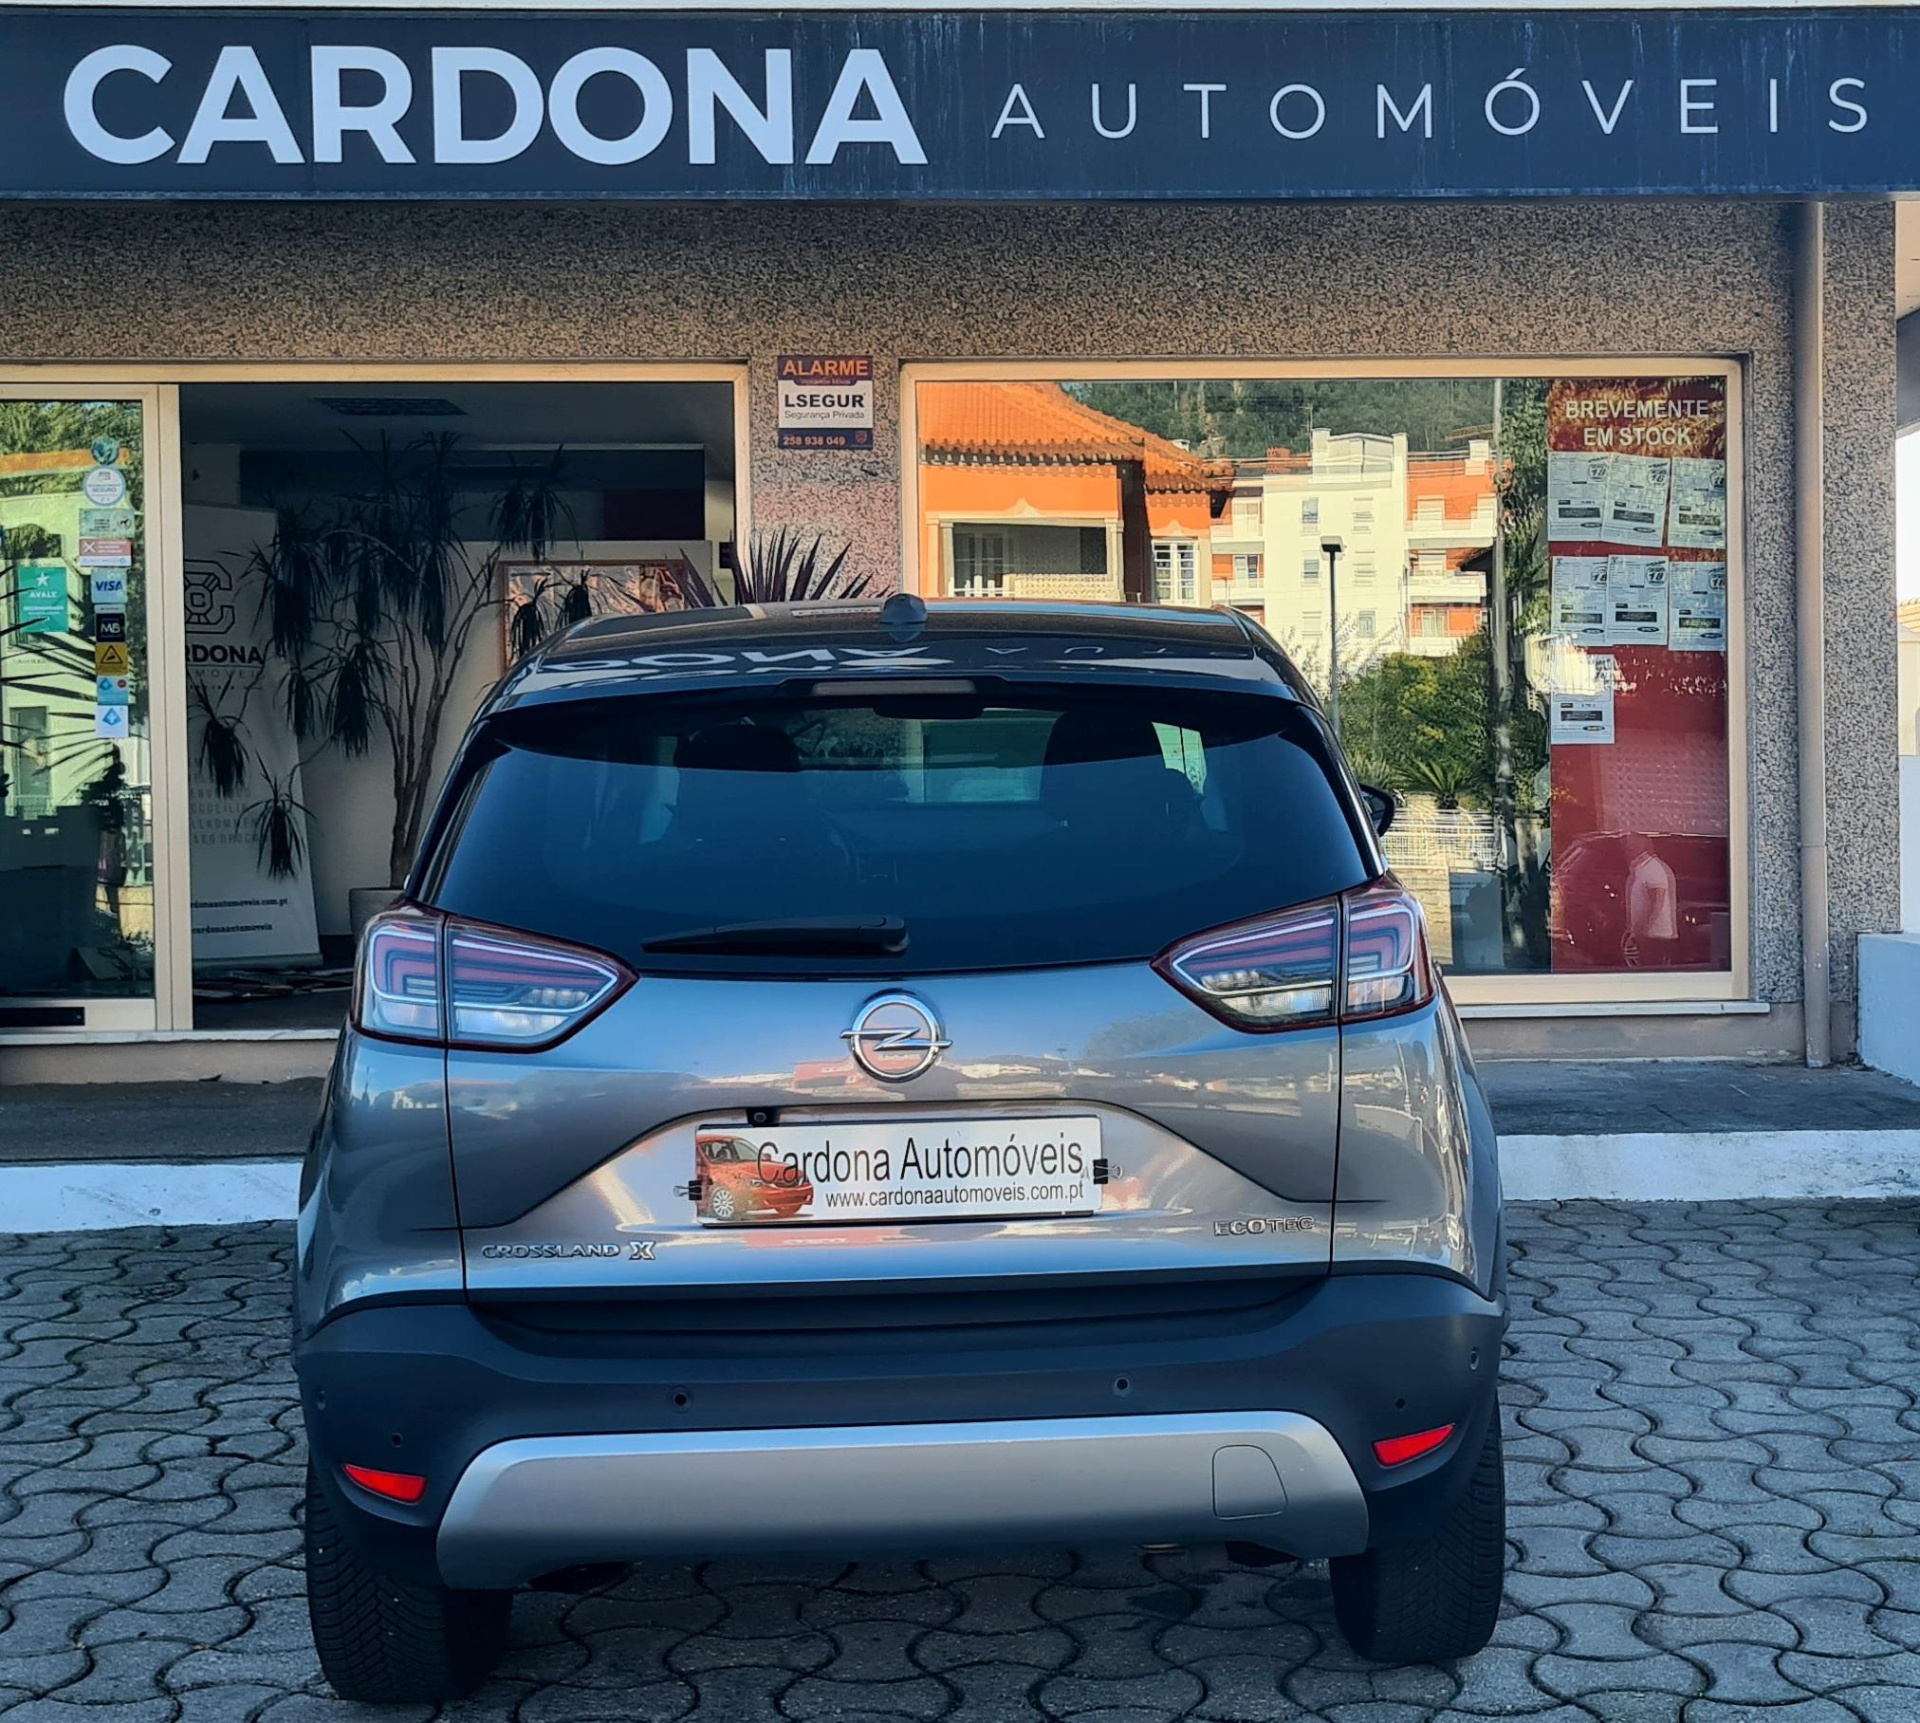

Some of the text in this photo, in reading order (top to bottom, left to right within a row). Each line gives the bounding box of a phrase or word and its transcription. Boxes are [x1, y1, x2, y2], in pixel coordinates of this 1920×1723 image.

[63, 44, 1868, 165] CARDONA AUTOMÓVEIS
[783, 360, 869, 376] ALARME
[784, 394, 865, 408] LSEGUR
[1565, 399, 1710, 419] BREVEMENTE
[784, 410, 865, 420] Segurança Privada
[1583, 427, 1693, 447] EM STOCK
[95, 580, 123, 592] VISA
[757, 1132, 1083, 1186] Cardona Automóveis
[825, 1181, 1085, 1208] www.cardonaautomoveis.com.pt
[1213, 1216, 1315, 1237] ECOTEC
[481, 1240, 657, 1261] CROSSLAND X
